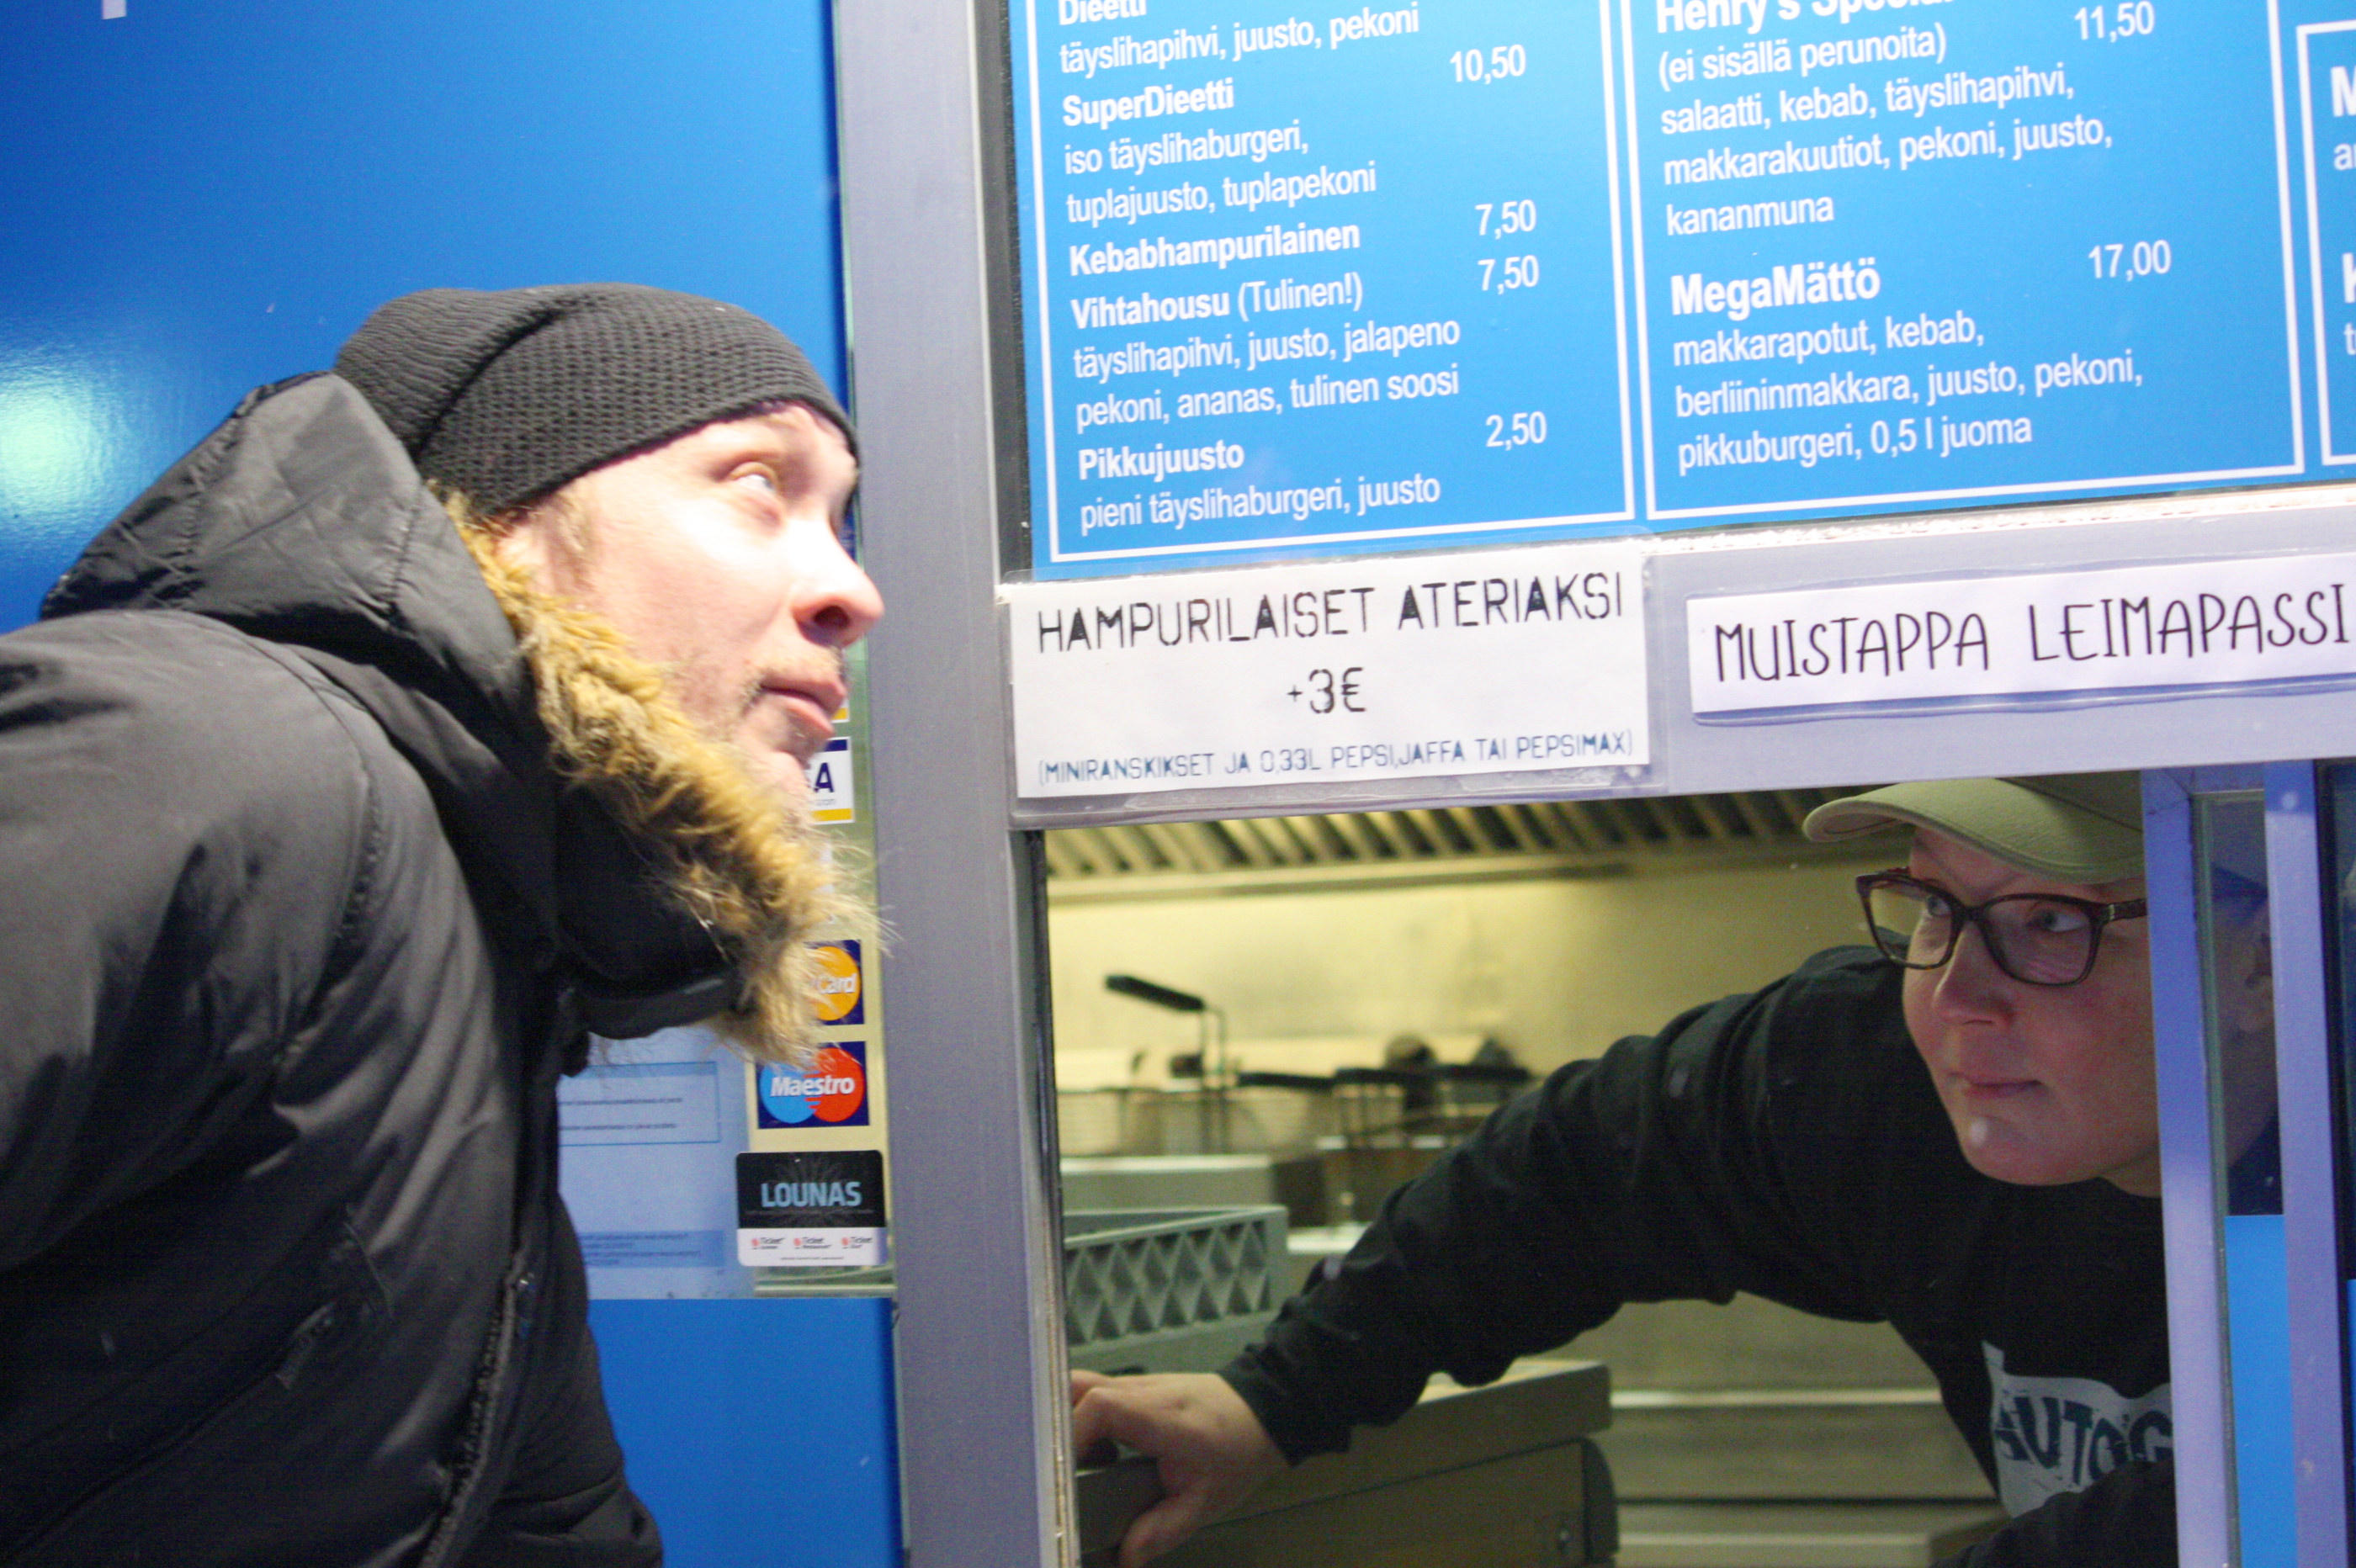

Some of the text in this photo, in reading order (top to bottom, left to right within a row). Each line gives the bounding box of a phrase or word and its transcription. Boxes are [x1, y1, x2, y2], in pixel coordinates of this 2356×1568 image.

[1060, 1, 1419, 78] täyslihapihvi, juusto, pekoni
[1656, 0, 1801, 34] Henrys
[2075, 0, 2155, 42] 11,50
[1451, 45, 1526, 83] 10,50
[1659, 23, 1946, 92] (ei sisällä perunoita)
[1064, 77, 1234, 130] SuperDieetti
[1662, 62, 2073, 135] salaatti, kebab, täyslihapihvi,
[1065, 119, 1308, 175] iso täyslihaburgeri,
[1664, 114, 2112, 184] makkarakuutiot, pekoni, juusto,
[1066, 161, 1376, 228] tuplajuusto, tuplapekoni
[1475, 199, 1536, 239] 7,50
[1667, 197, 1833, 236] kananmuna
[1070, 222, 1360, 276] Kebabhampurilainen
[1478, 255, 1539, 294] 7,50
[2089, 240, 2171, 281] 17,00
[1071, 272, 1362, 329] Vihtahousu (Tulinen!)
[1671, 257, 1881, 320] MegaMättö
[1074, 320, 1460, 384] täyslihapihvi, juusto, jalapeno
[1674, 310, 1983, 366] makkarapotut, kebab,
[1077, 363, 1458, 434] pekoni, ananas, tulinen soosi
[1676, 349, 2142, 417] berliininmakkara, juusto, pekoni,
[1486, 411, 1547, 450] 2,50
[1679, 423, 1861, 476] pikkuburgeri,
[1870, 418, 1917, 457] 0,5
[1940, 416, 2032, 458] juoma
[1080, 440, 1244, 482] Pikkujuusto
[1081, 474, 1441, 536] pieni täyslihaburgeri, juusto
[1039, 573, 1621, 653] HAMPURILAISET ATERIAKSI
[1716, 584, 2349, 681] MUISTAPPA LEIMAPASSI
[1287, 667, 1366, 713] +3€
[1038, 750, 1214, 787] (MINIRANSKIKSET
[1225, 750, 1250, 774] JA
[1260, 748, 1321, 775] 0,33L
[1474, 739, 1506, 760] TAI
[1517, 729, 1633, 760] PEPSIMAX)
[771, 1074, 855, 1096] Maestro
[761, 1182, 862, 1208] LOUNAS
